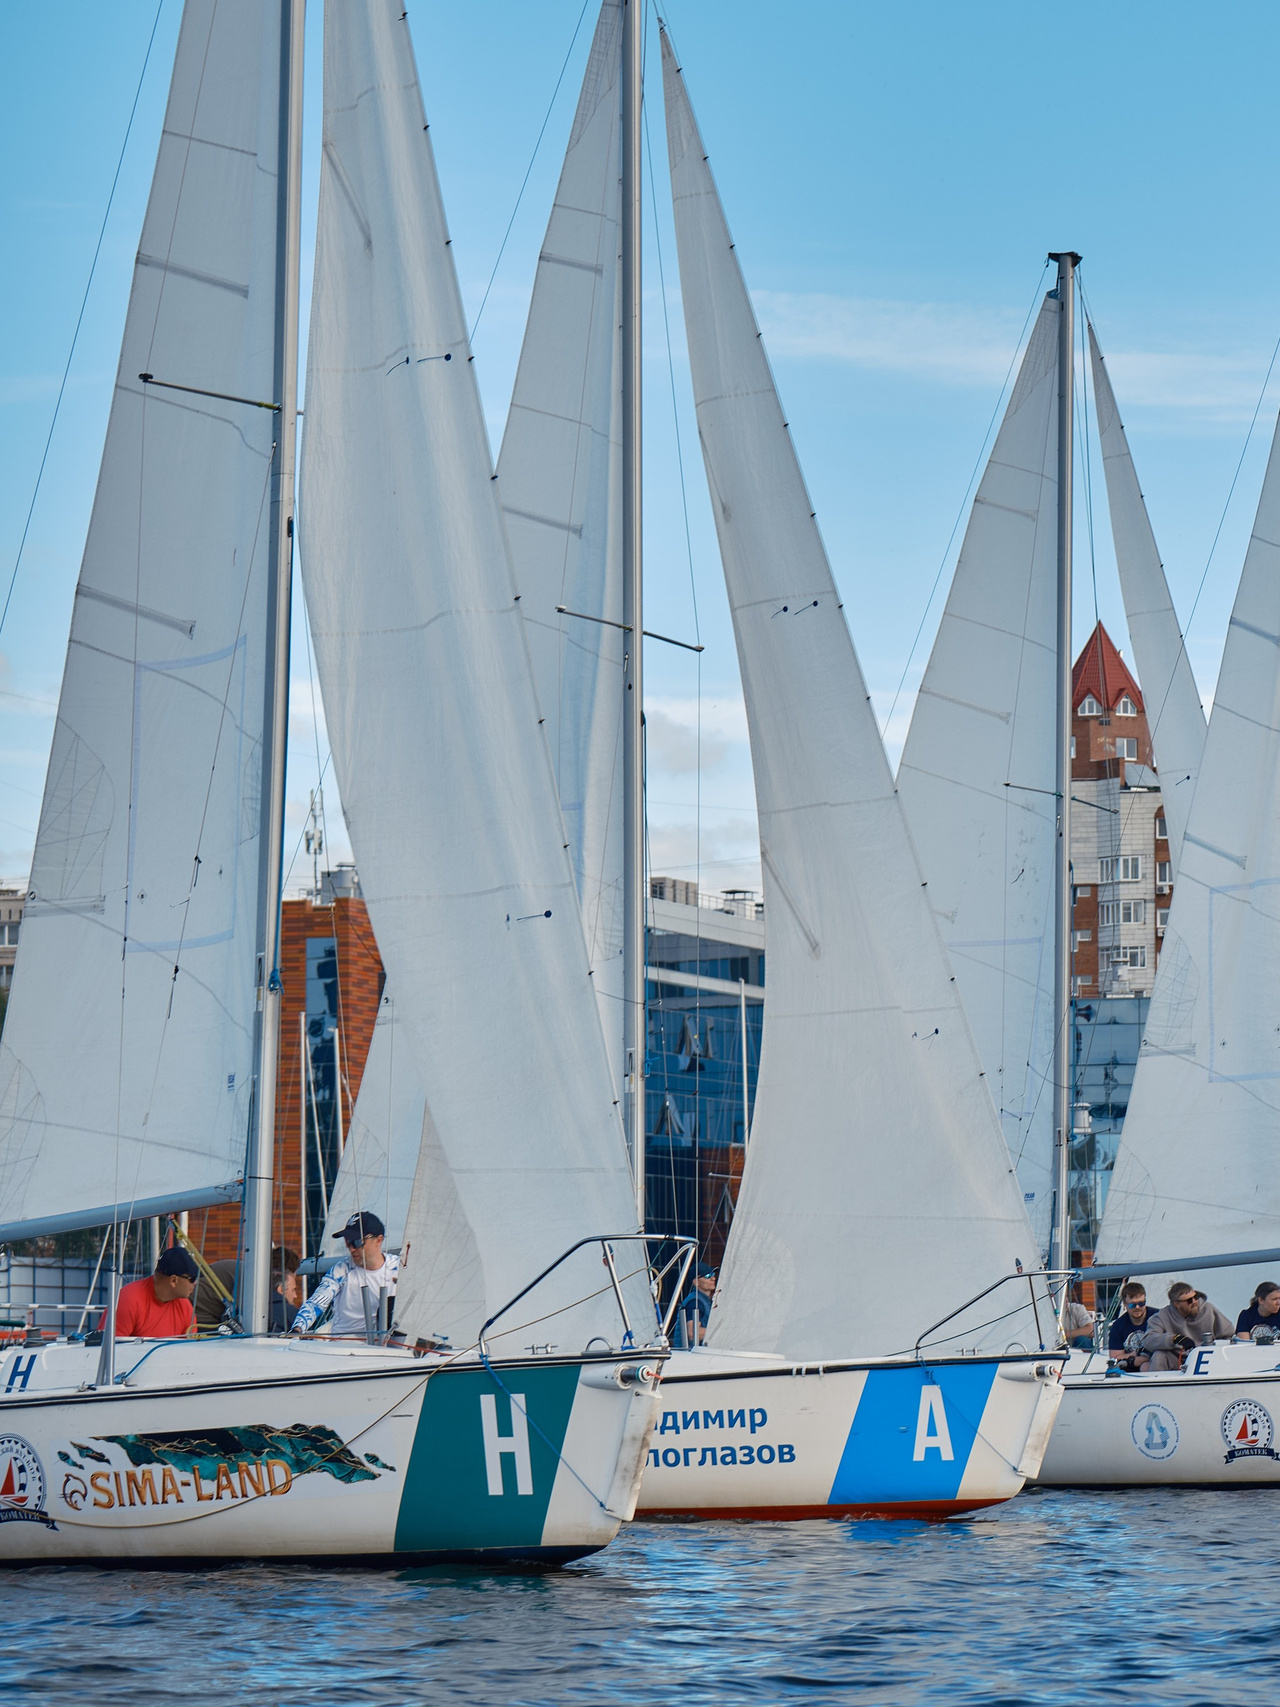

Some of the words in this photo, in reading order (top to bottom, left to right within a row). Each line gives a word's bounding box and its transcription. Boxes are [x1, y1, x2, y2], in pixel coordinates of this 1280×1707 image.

[4, 1353, 38, 1393] H
[1193, 1350, 1214, 1376] E
[653, 1406, 768, 1435] димир
[912, 1384, 955, 1462] A
[479, 1392, 534, 1496] H
[89, 1458, 293, 1510] SIMA-LAND
